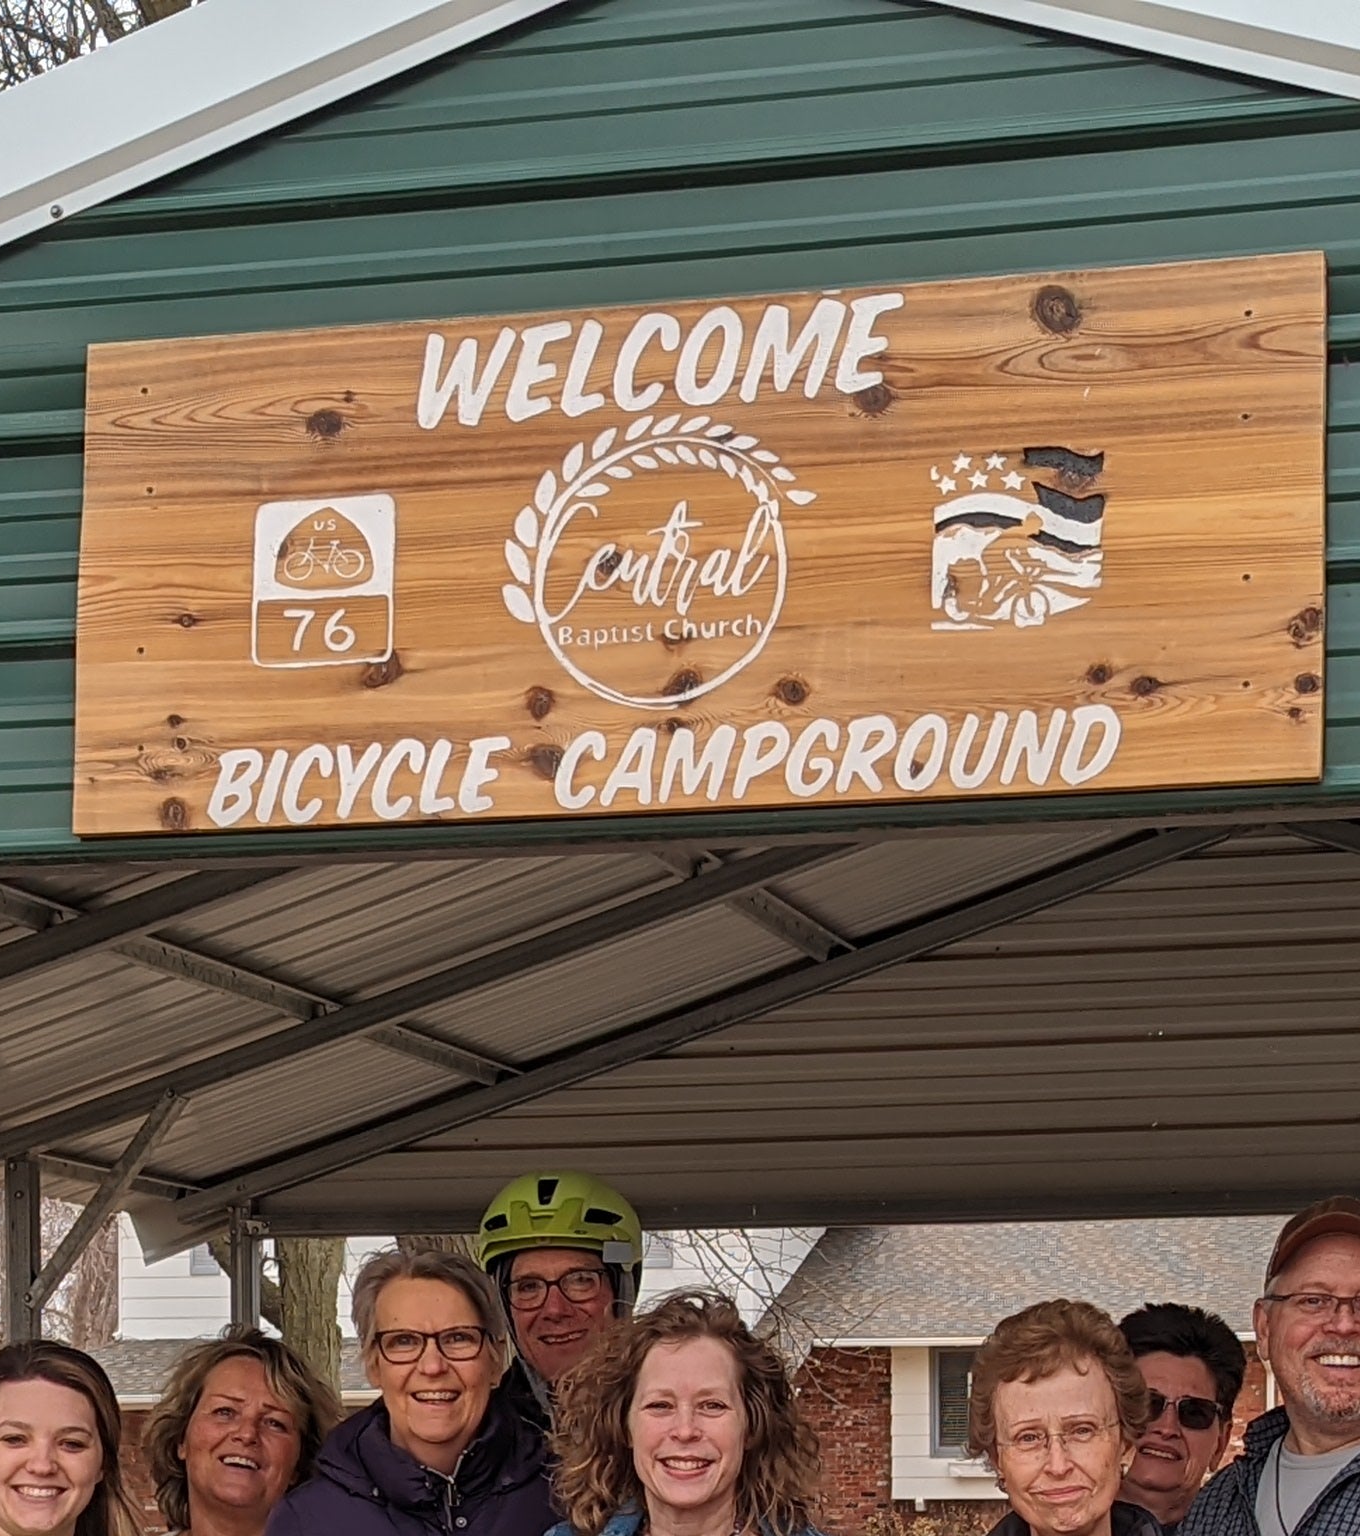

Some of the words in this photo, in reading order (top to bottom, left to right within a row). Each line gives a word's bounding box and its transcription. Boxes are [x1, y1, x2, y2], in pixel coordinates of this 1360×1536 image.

[417, 291, 904, 430] WELCOME
[313, 518, 337, 531] US
[540, 500, 771, 624] Central
[283, 608, 356, 652] 76
[558, 622, 655, 650] Baptist
[663, 614, 763, 640] Church
[207, 734, 512, 829] BICYCLE
[553, 703, 1121, 811] CAMPGROUND
